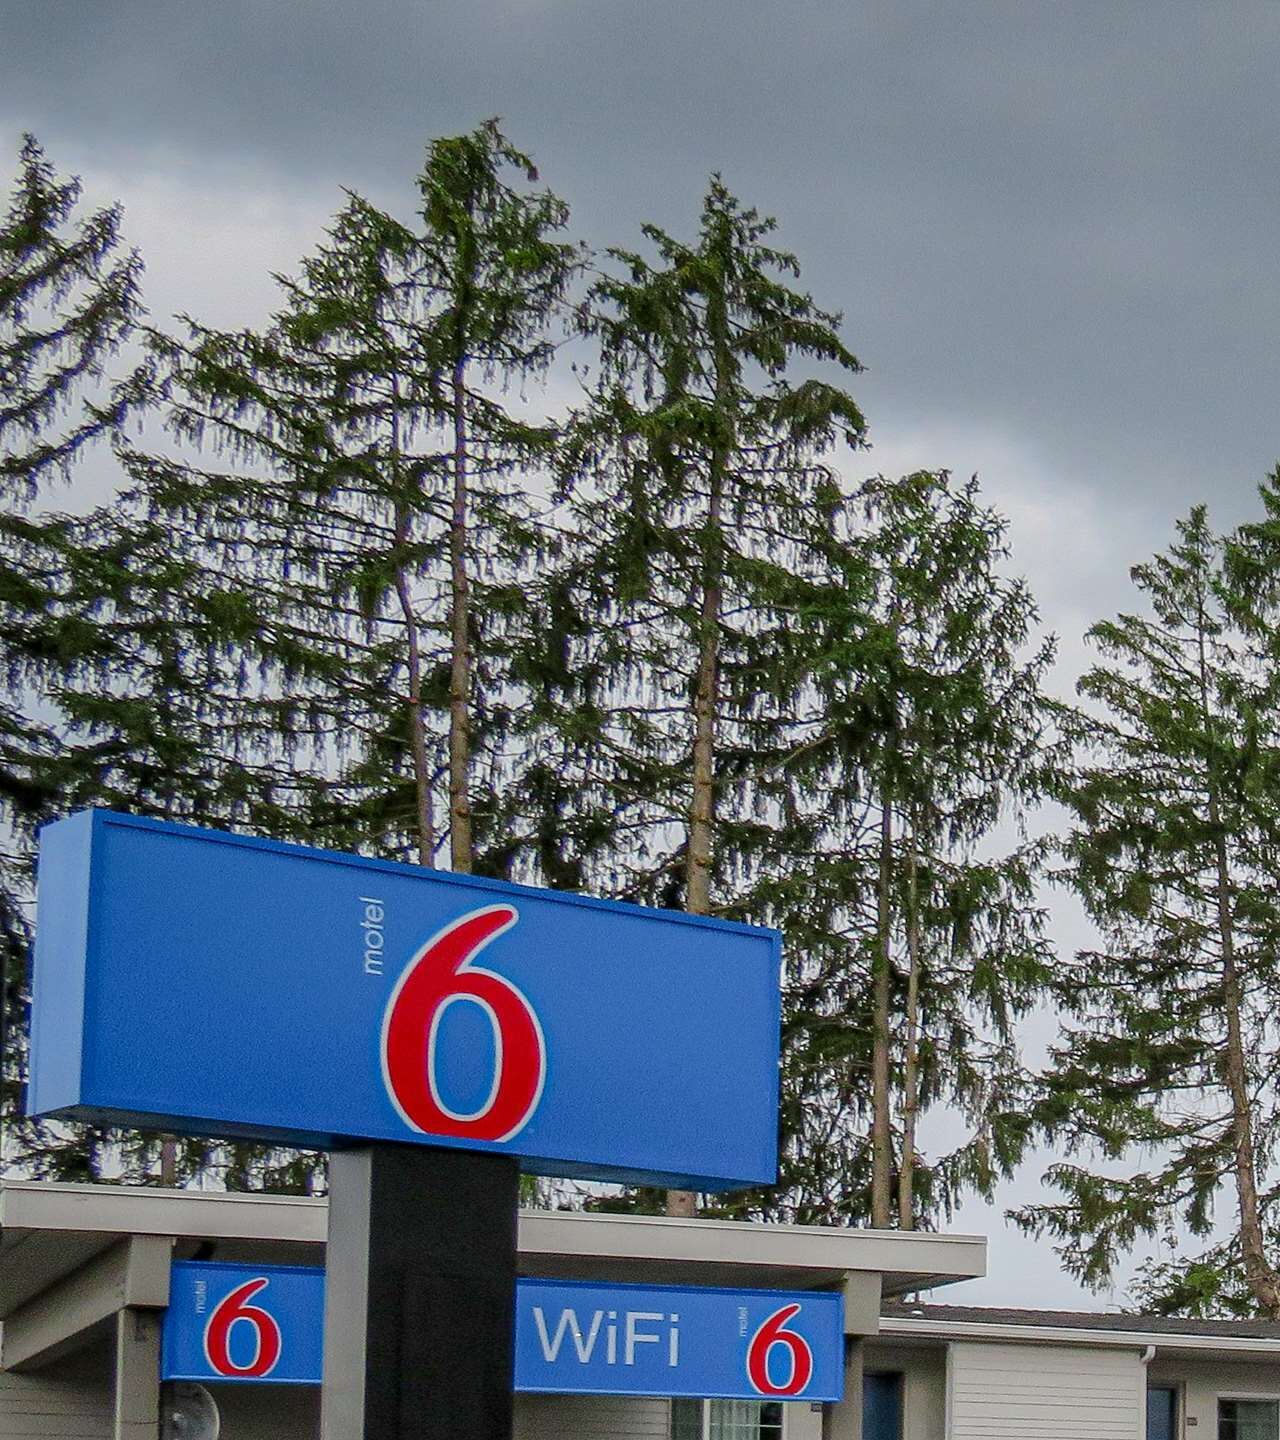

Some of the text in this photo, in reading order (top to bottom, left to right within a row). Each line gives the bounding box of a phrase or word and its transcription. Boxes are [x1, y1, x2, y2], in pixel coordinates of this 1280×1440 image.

[359, 897, 385, 975] motel
[380, 903, 546, 1143] 6
[203, 1277, 282, 1378] 6
[533, 1306, 679, 1367] WiFi
[746, 1302, 813, 1396] 6
